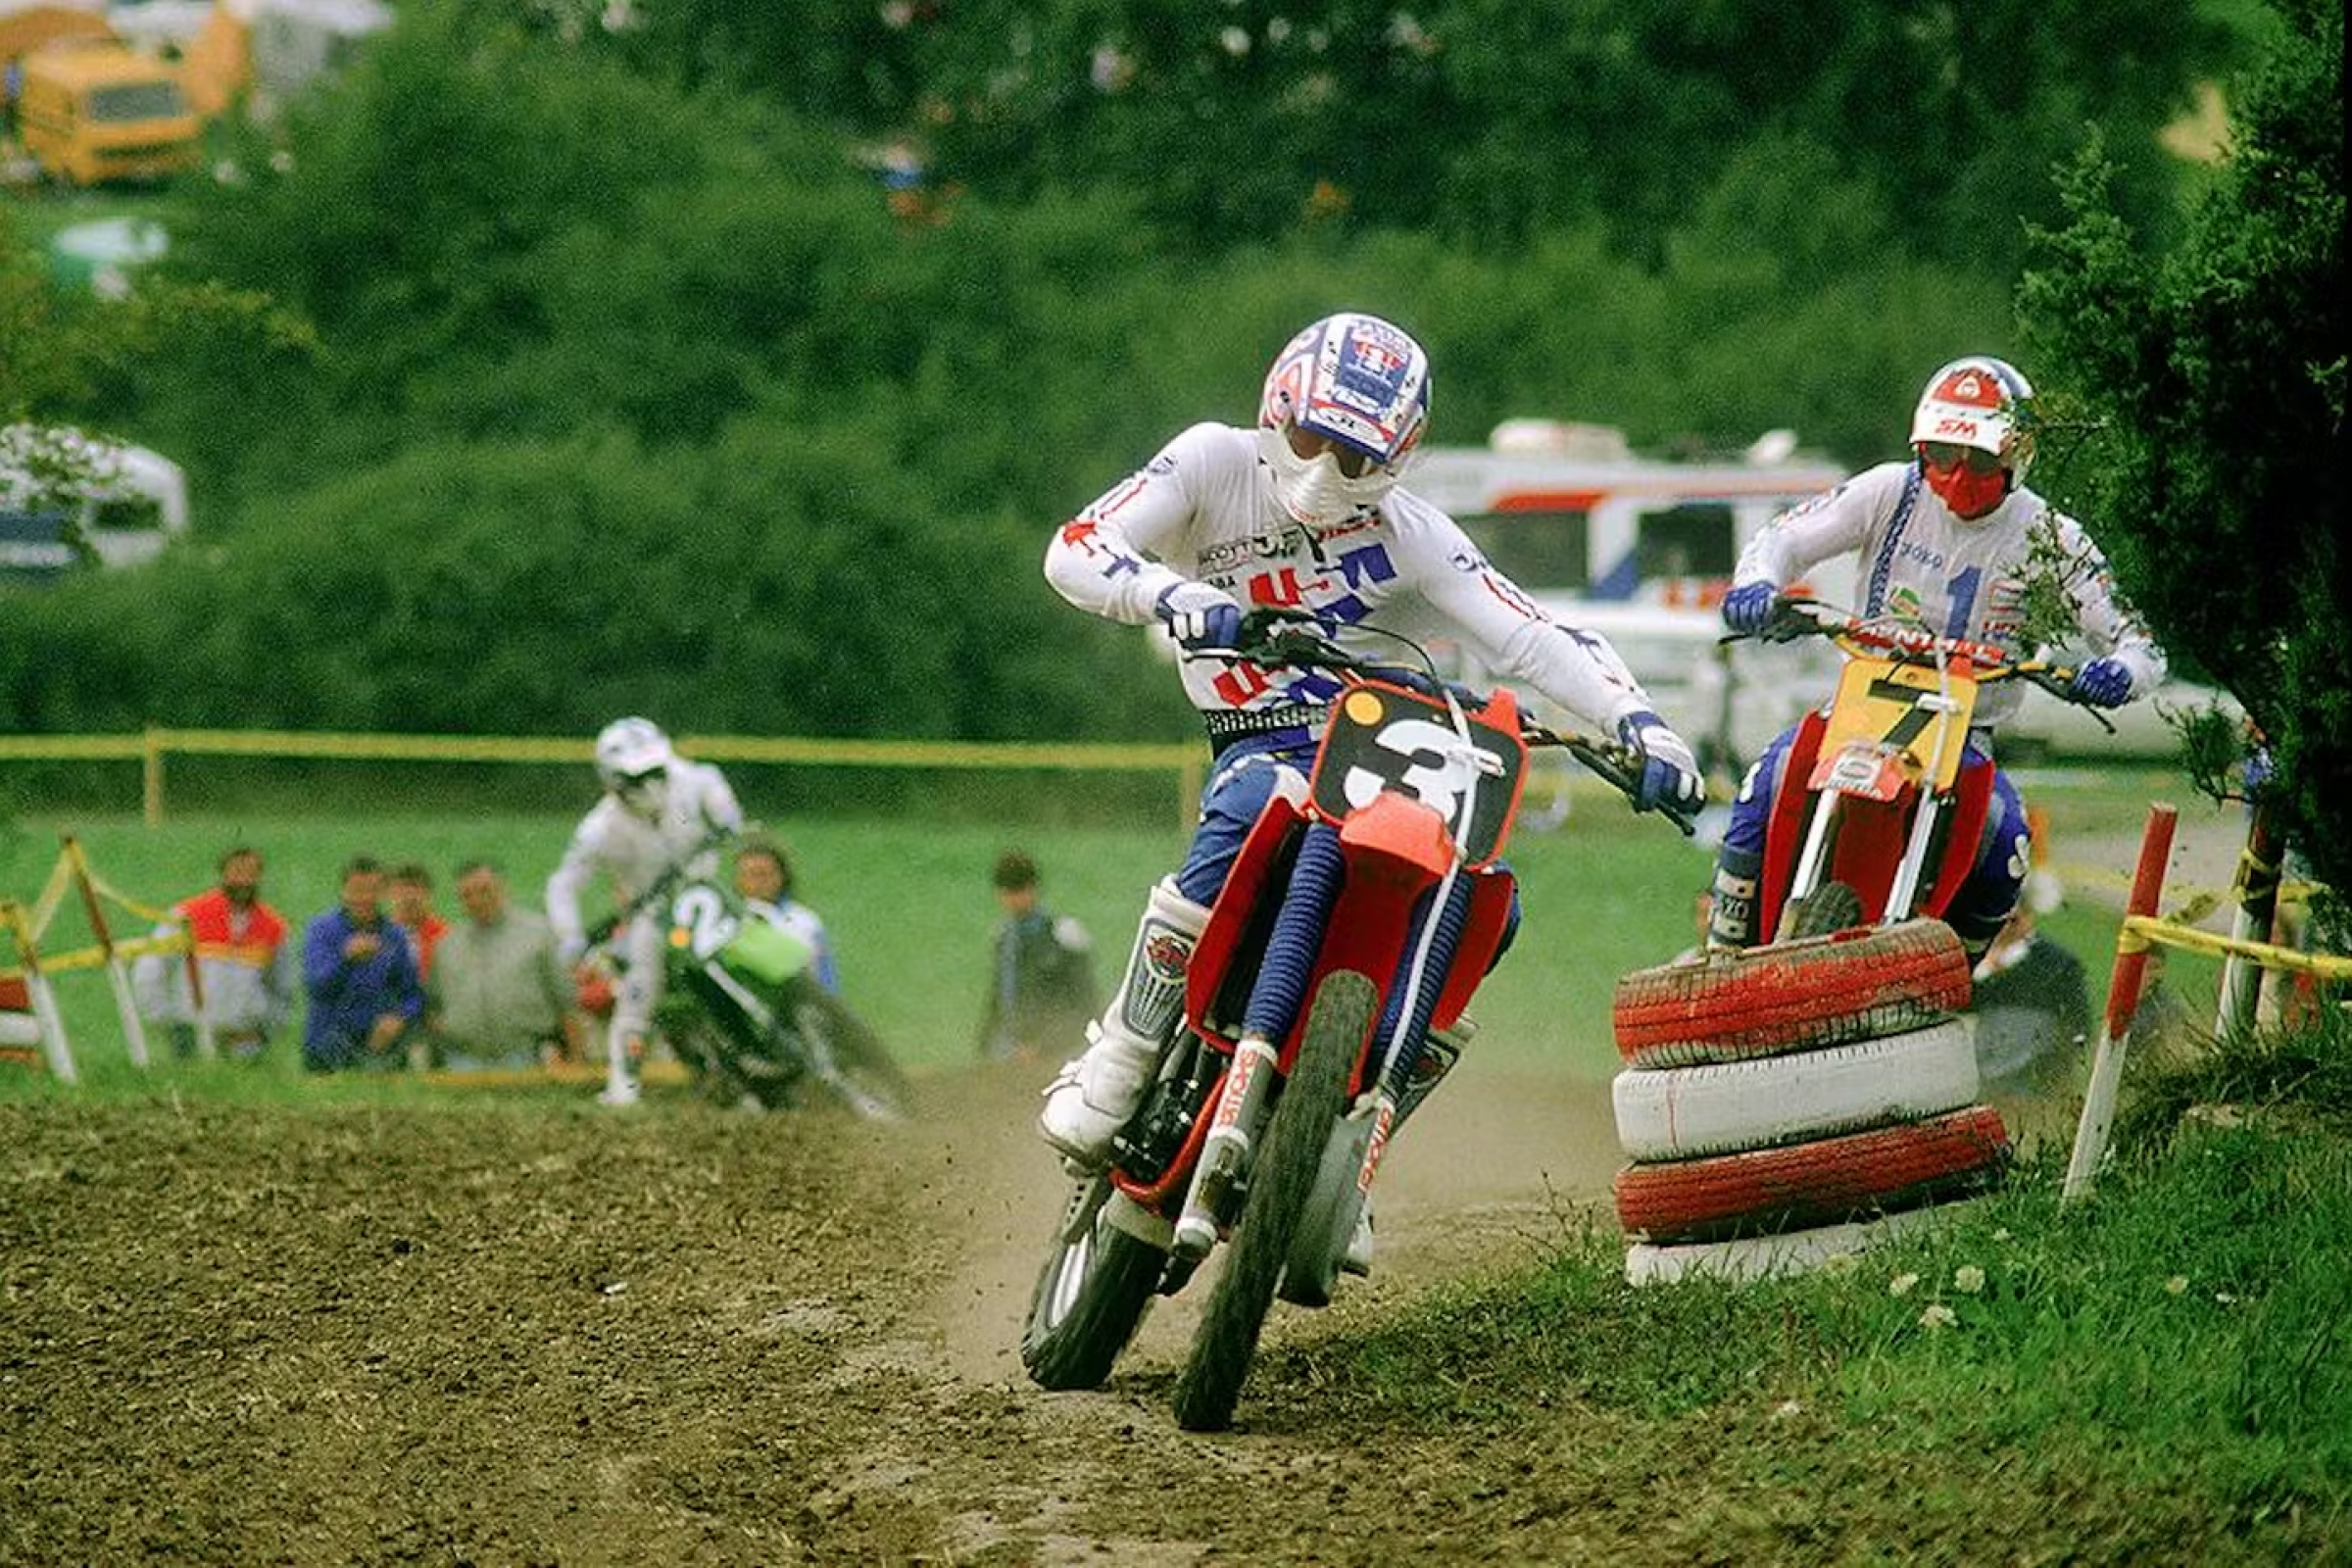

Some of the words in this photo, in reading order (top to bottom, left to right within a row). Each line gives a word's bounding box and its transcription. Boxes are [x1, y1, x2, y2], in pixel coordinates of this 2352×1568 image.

[1947, 565, 1982, 640] 1
[1868, 678, 1942, 748] 7
[1344, 718, 1474, 824] 3
[673, 885, 735, 959] 2
